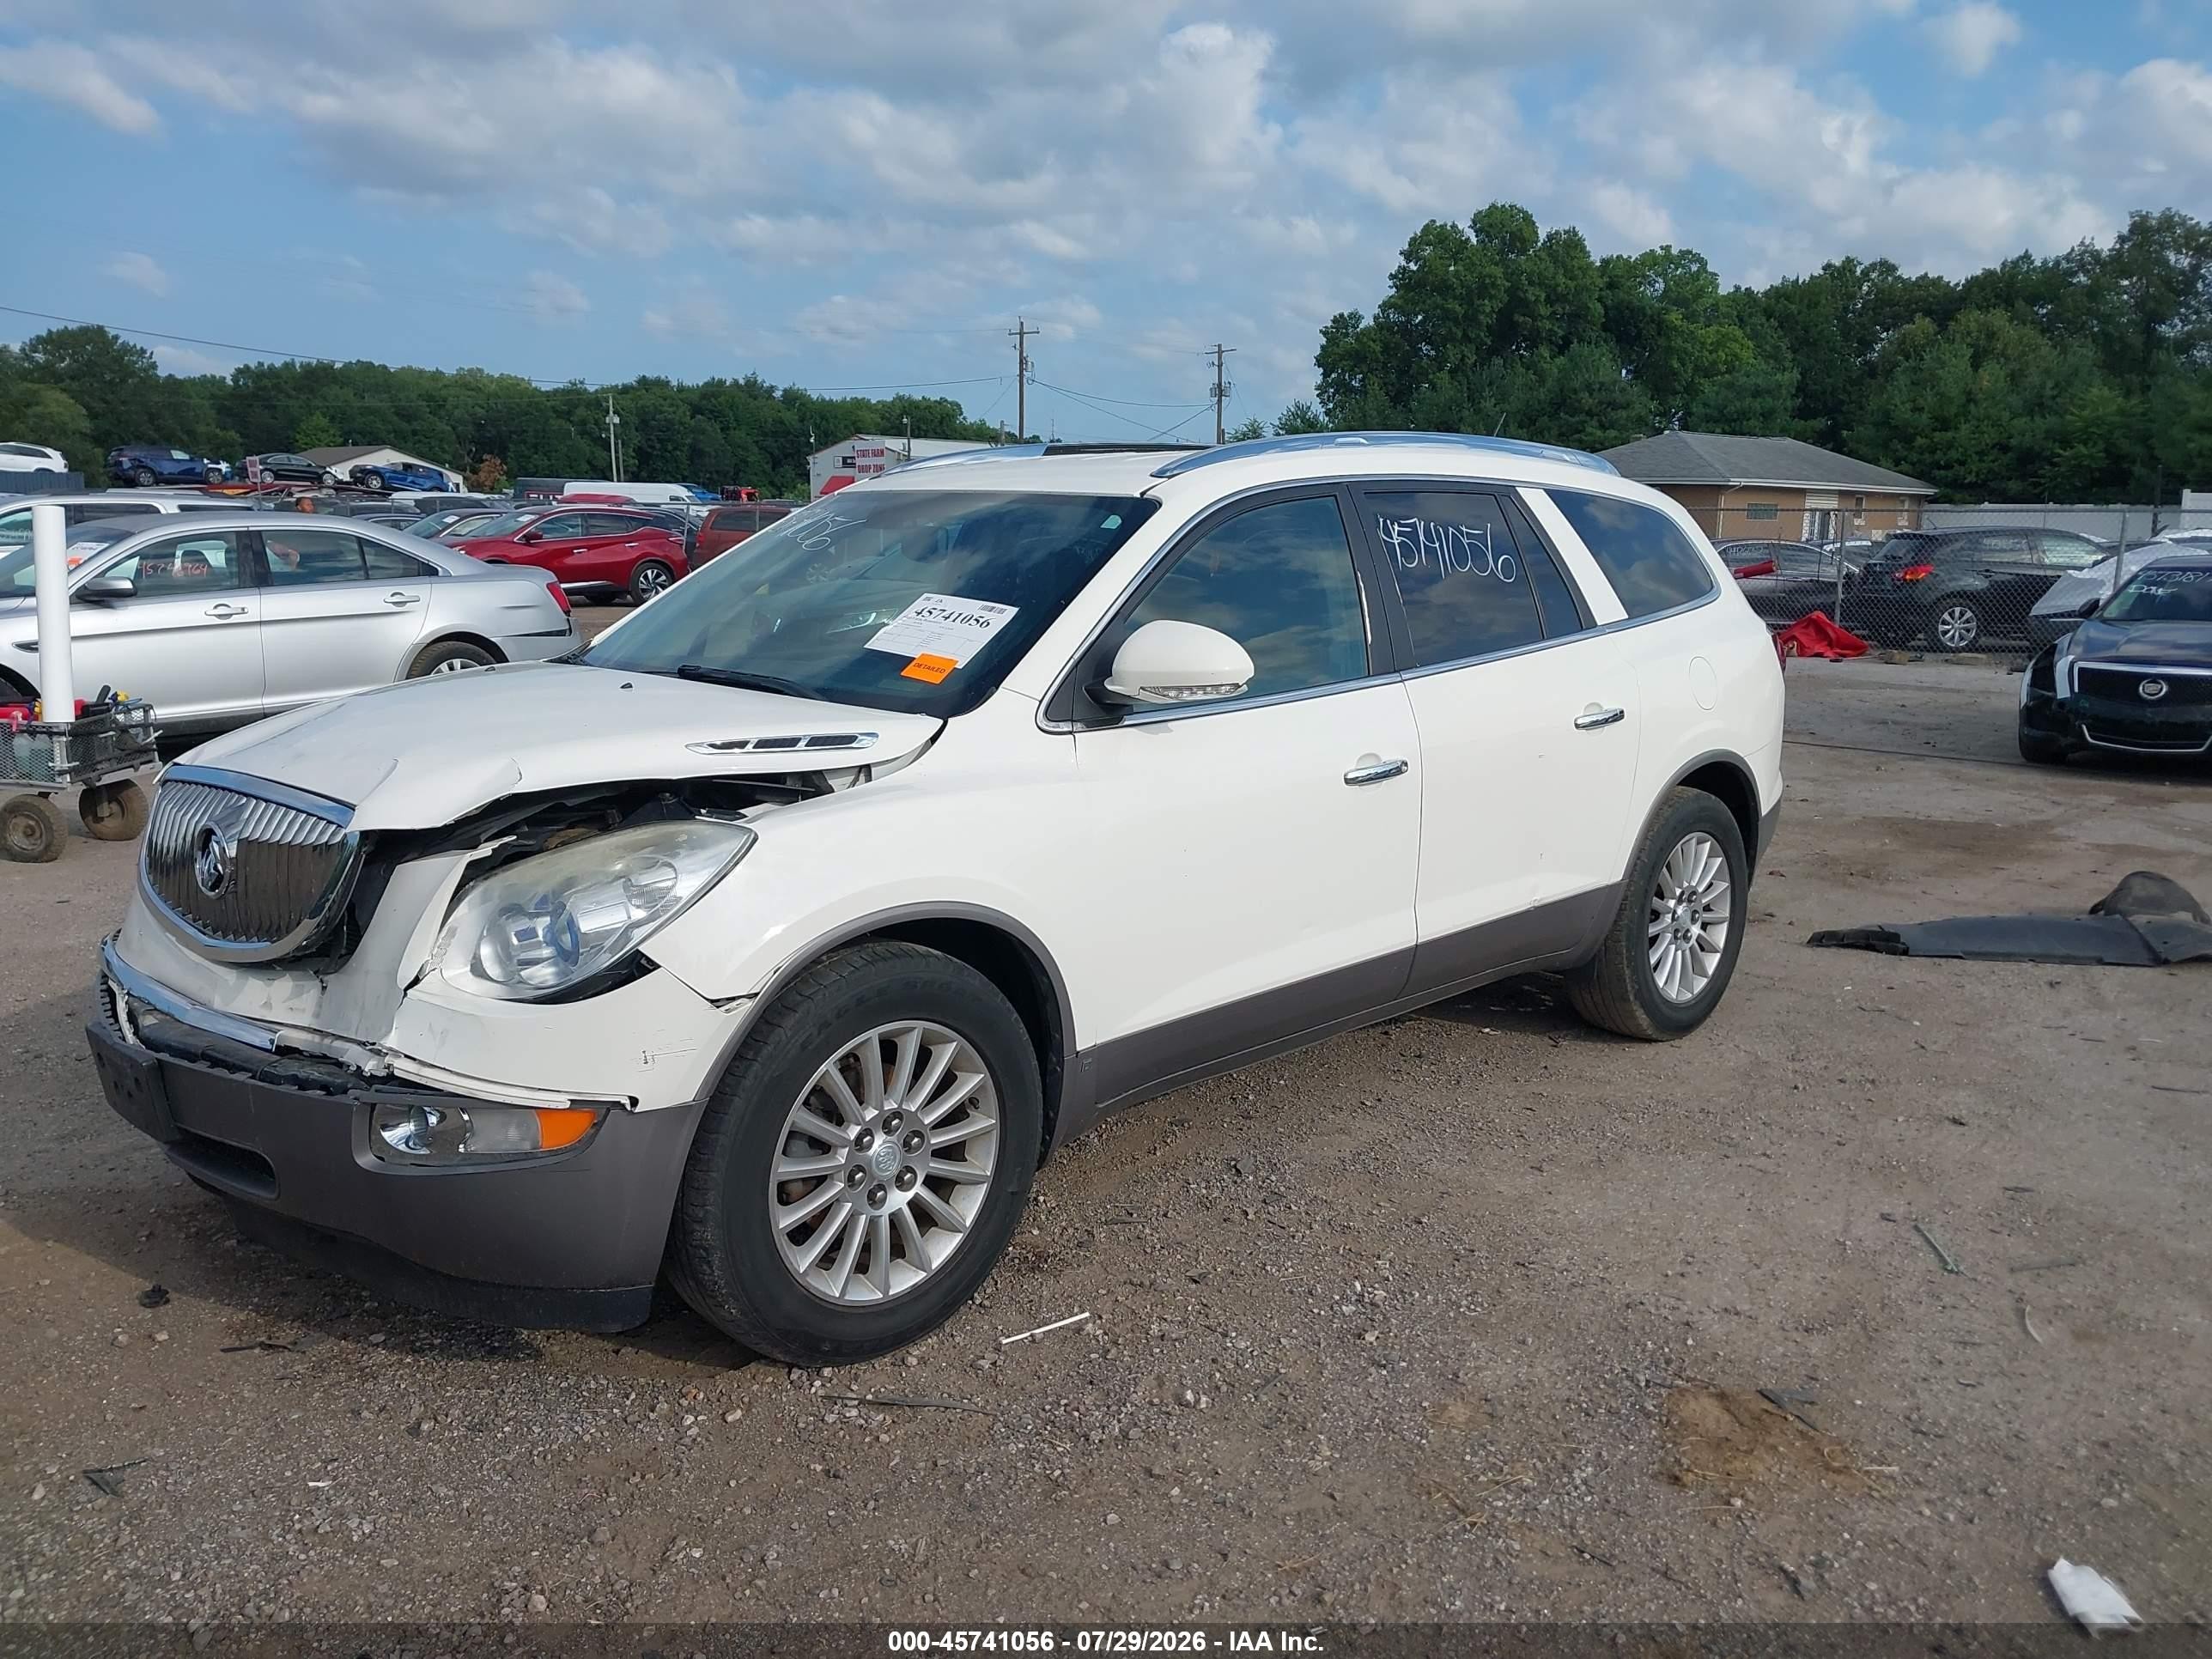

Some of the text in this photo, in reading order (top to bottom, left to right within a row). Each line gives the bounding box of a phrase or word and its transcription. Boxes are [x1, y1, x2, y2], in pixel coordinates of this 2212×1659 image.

[856, 448, 885, 458] STATE FARM
[857, 464, 872, 473] DROP
[1378, 514, 1516, 583] 45741056
[915, 606, 996, 629] 45741056
[913, 662, 947, 675] DETAILED
